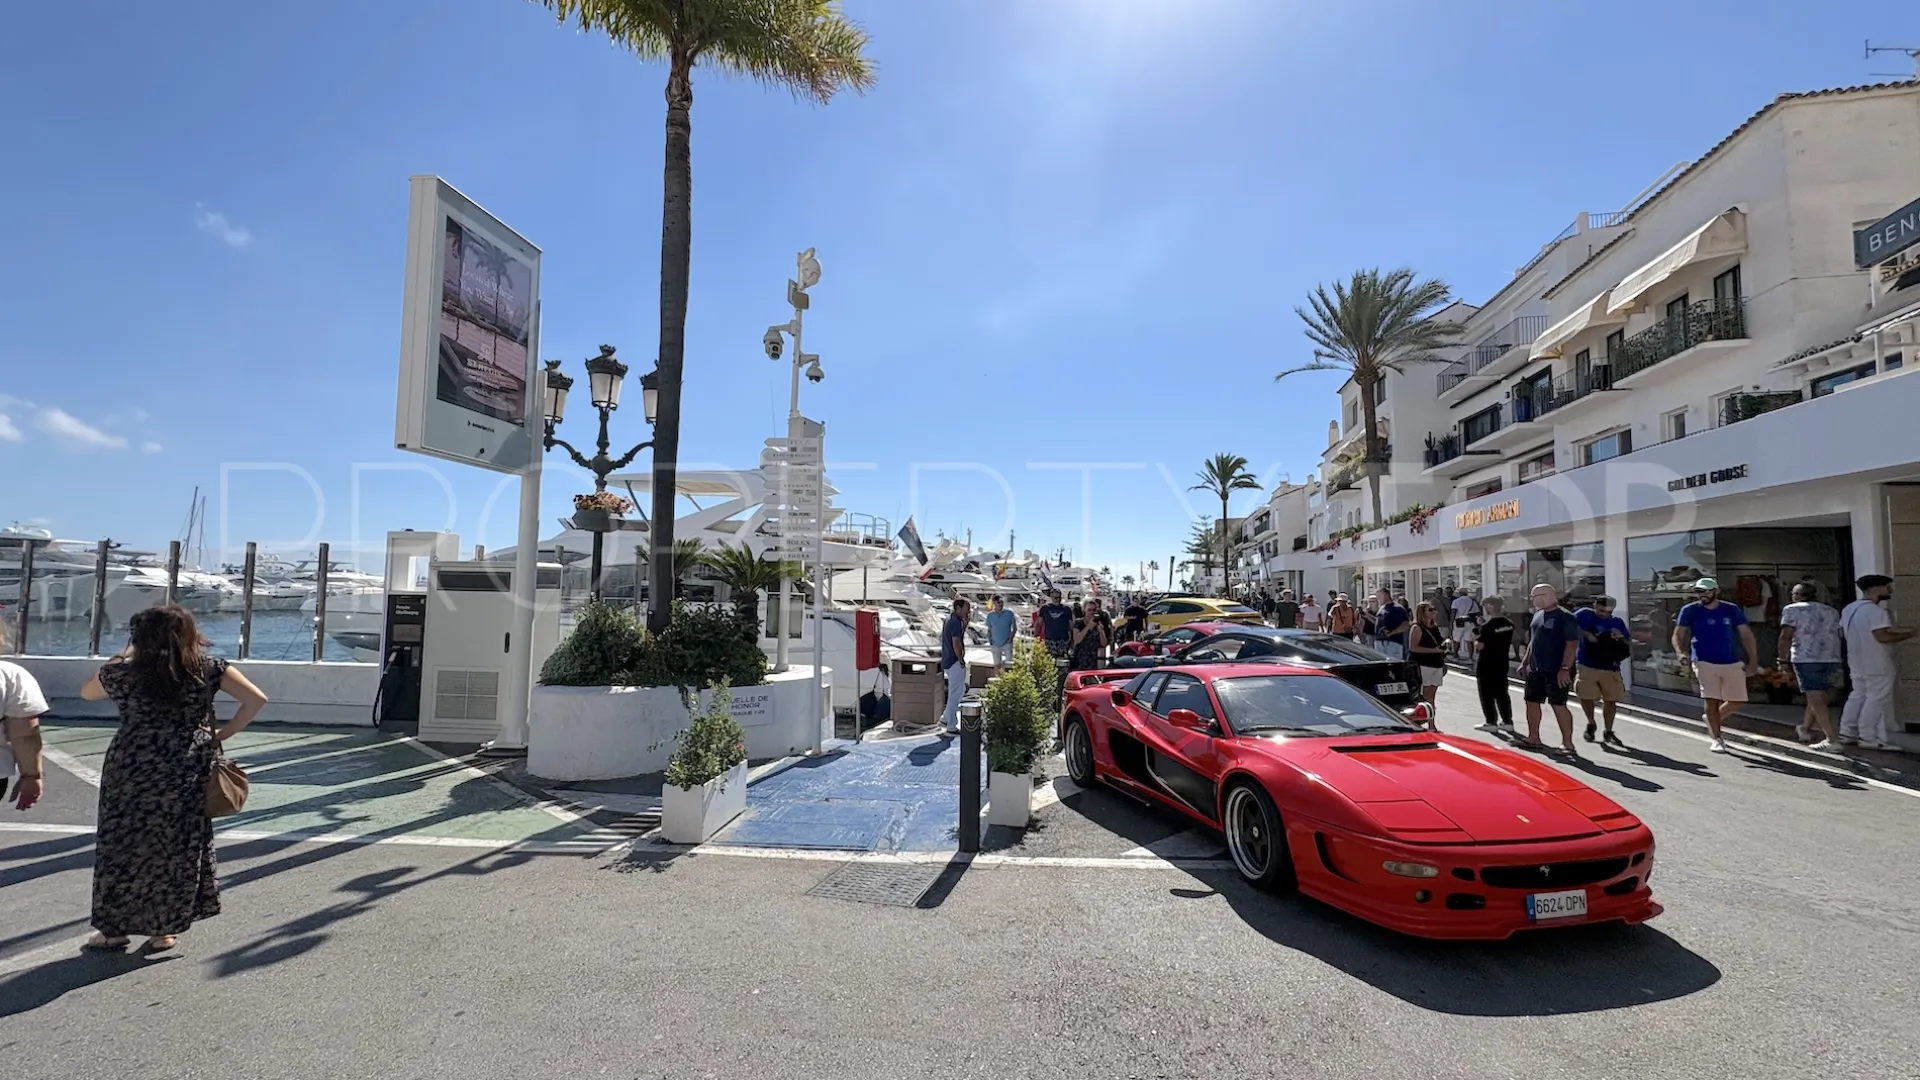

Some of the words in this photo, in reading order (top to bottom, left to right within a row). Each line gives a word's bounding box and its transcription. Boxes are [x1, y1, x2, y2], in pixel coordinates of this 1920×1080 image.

[1869, 209, 1920, 252] BEN
[1667, 473, 1707, 492] GOLDEN
[1710, 464, 1749, 484] GOOSE
[1535, 897, 1563, 914] 6624
[1565, 895, 1586, 911] DPN
